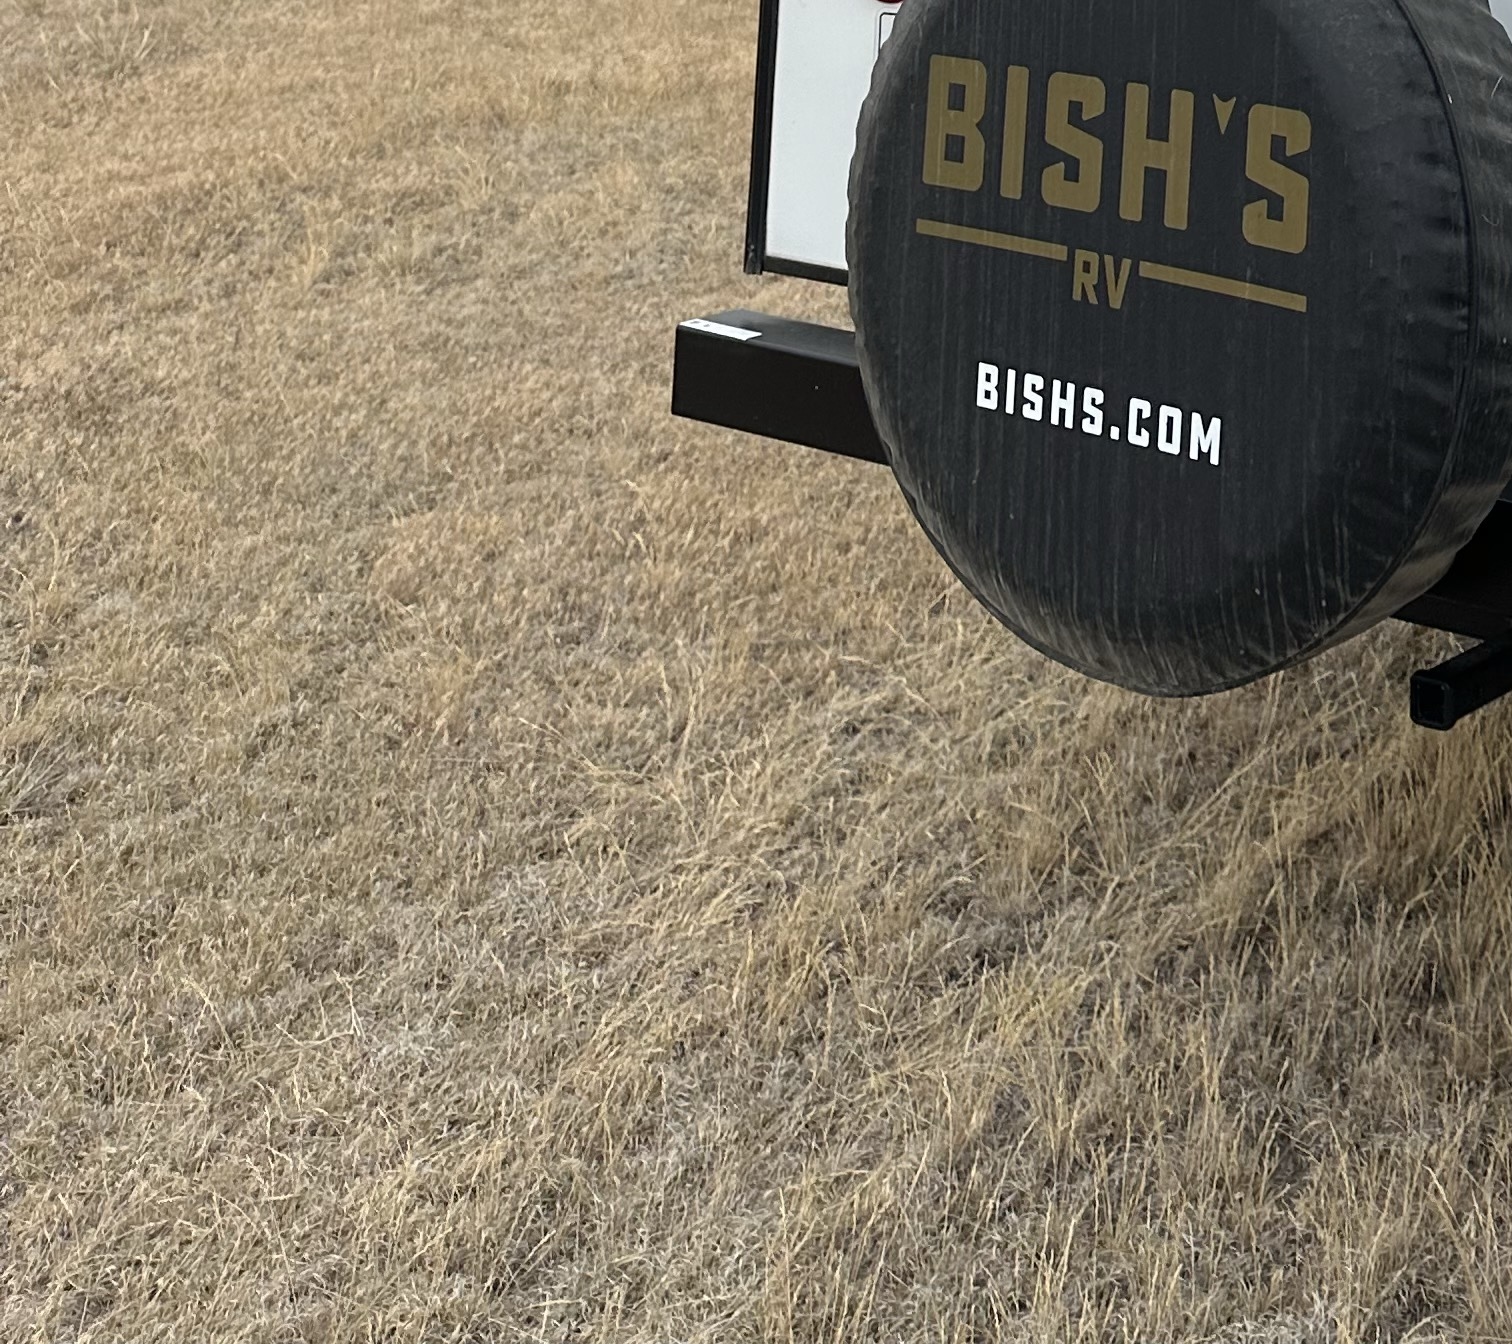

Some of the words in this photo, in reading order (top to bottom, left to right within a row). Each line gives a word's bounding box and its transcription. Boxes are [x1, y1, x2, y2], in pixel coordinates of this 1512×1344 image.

[921, 53, 1312, 254] BISH'S
[1071, 248, 1132, 310] RV
[975, 361, 1222, 466] BISHS.COM
